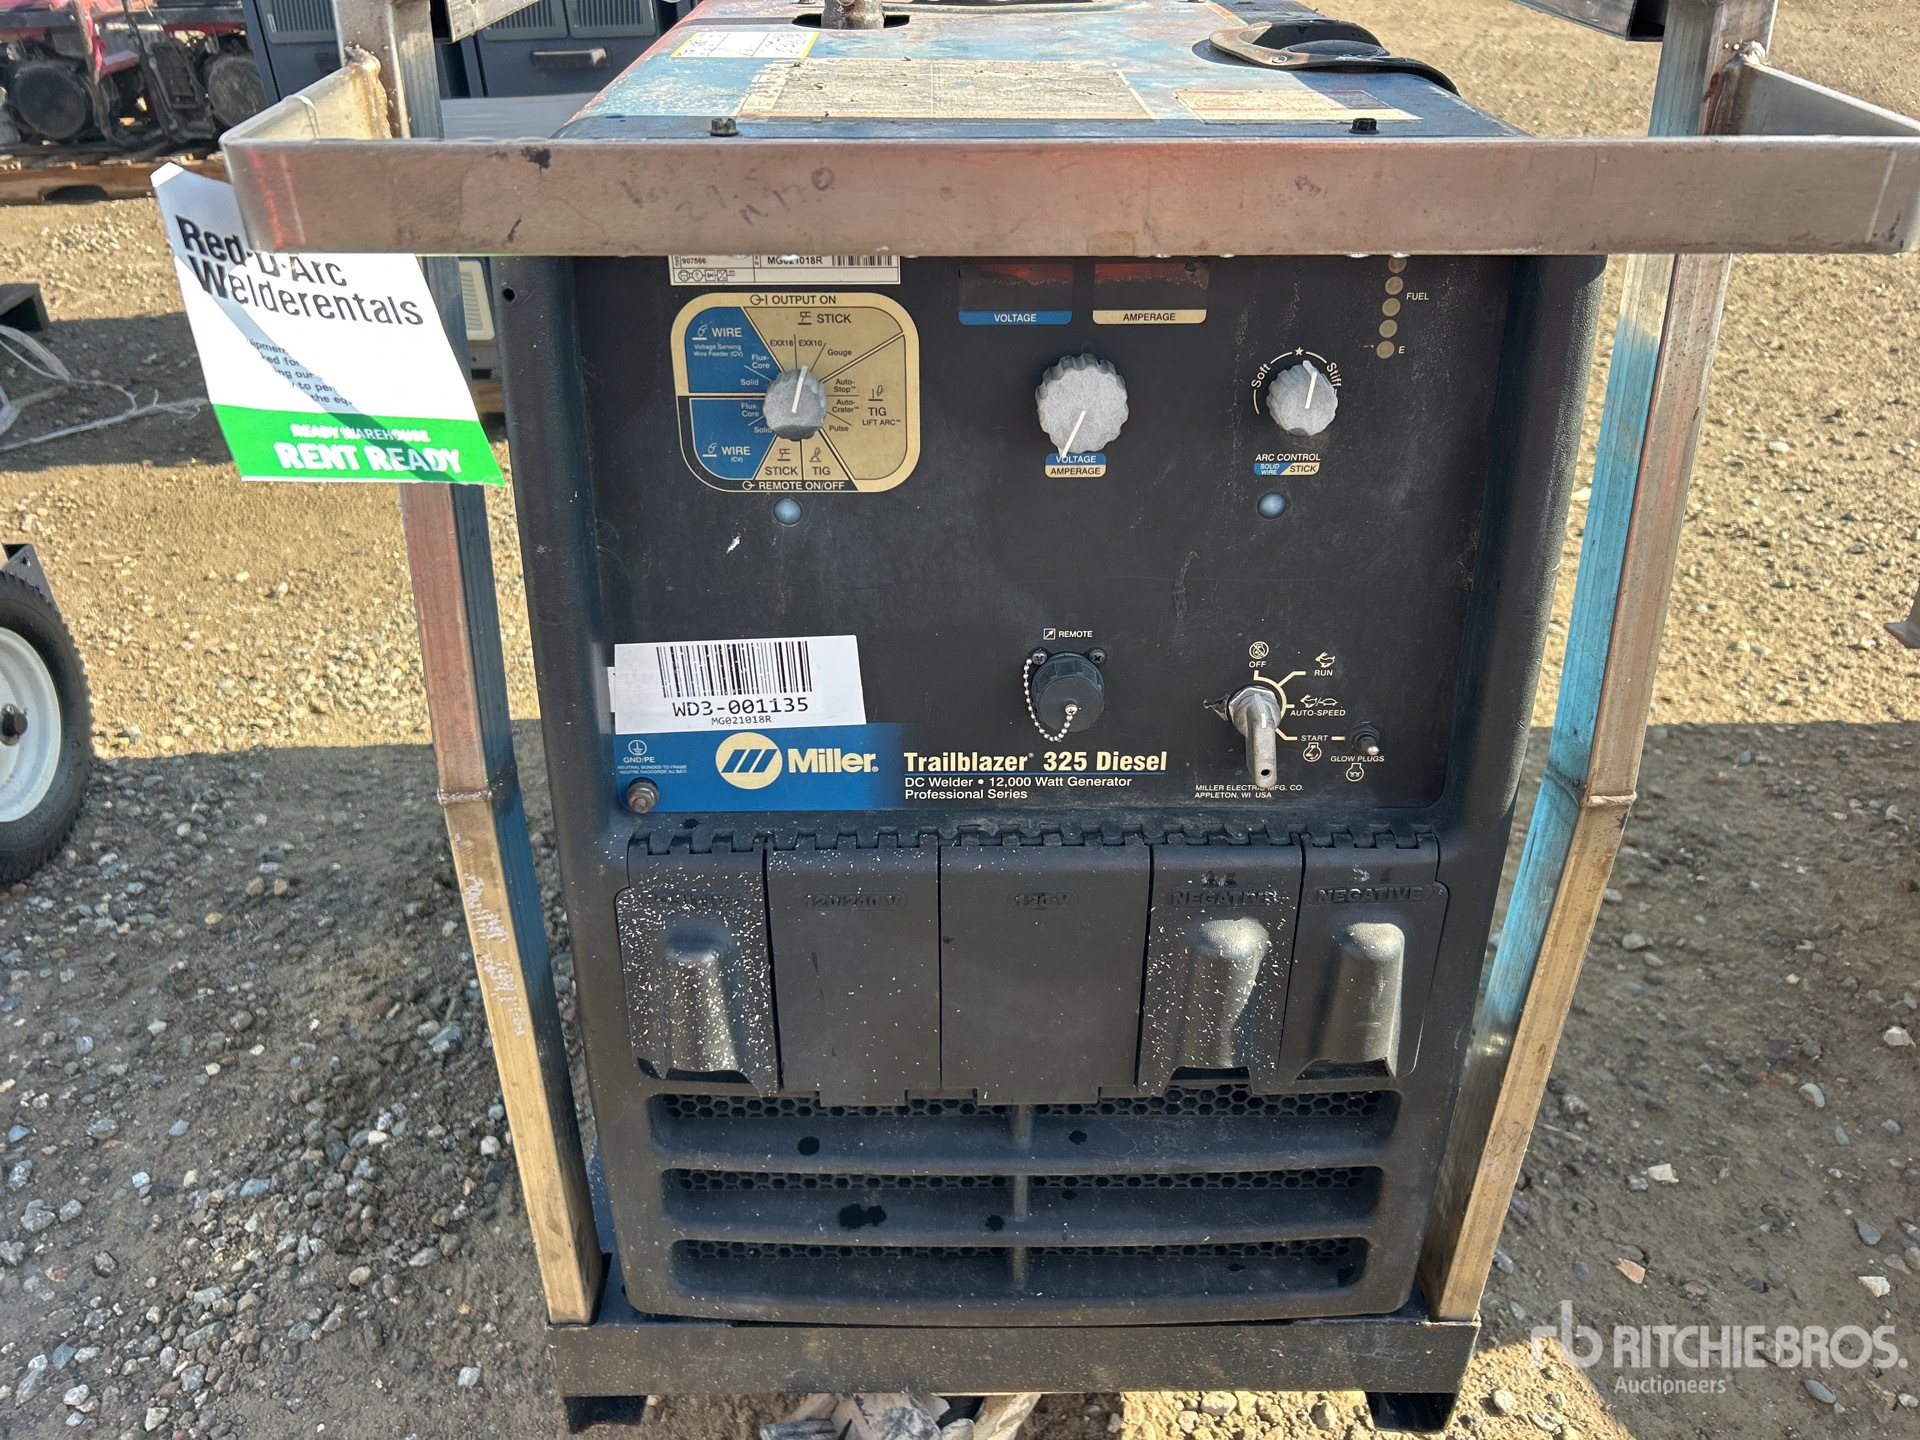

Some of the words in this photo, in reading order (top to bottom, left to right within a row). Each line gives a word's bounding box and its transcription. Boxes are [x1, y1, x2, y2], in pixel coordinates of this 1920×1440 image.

[188, 254, 424, 326] Welderentals
[772, 295, 815, 305] OUTPUT
[819, 295, 837, 304] ON
[816, 313, 852, 324] STICK
[994, 313, 1037, 323] VOLTAGE
[1122, 312, 1176, 322] AMPERAGE
[711, 327, 743, 338] WIRE
[827, 348, 852, 358] Gouge
[1398, 345, 1406, 355] E
[752, 361, 770, 369] Core
[1251, 362, 1272, 389] Soft
[1326, 362, 1342, 388] Stiff
[741, 402, 759, 410] Flux-
[868, 407, 887, 416] TIG
[340, 427, 431, 443] WAREHOUSE
[721, 446, 751, 456] WIRE
[273, 442, 360, 471] RENT
[363, 445, 462, 474] READY
[1055, 455, 1097, 464] VOLTAGE
[1255, 453, 1275, 462] ARC
[1276, 453, 1321, 462] CONTROL
[765, 466, 798, 477] STICK
[812, 465, 831, 477] TIG
[1050, 467, 1101, 475] AMPERAGE
[1289, 465, 1317, 473] STICK
[758, 480, 802, 491] REMOTE
[805, 480, 845, 491] ON/OFF
[1058, 630, 1093, 638] REMOTE
[672, 697, 809, 717] WD3-001135
[1290, 709, 1346, 717] AUTO-SPEED
[711, 715, 772, 726] MG021018R
[1043, 751, 1087, 771] 325
[1096, 751, 1168, 771] Diesel
[905, 777, 925, 788] DC
[929, 776, 973, 788] Welder
[989, 777, 1031, 788] 12,000
[1035, 776, 1063, 787] Watt
[1067, 776, 1132, 787] Generator
[905, 788, 984, 800] Professional
[987, 788, 1028, 799] Series
[1317, 887, 1423, 901] NEGATIVE
[887, 895, 902, 907] V
